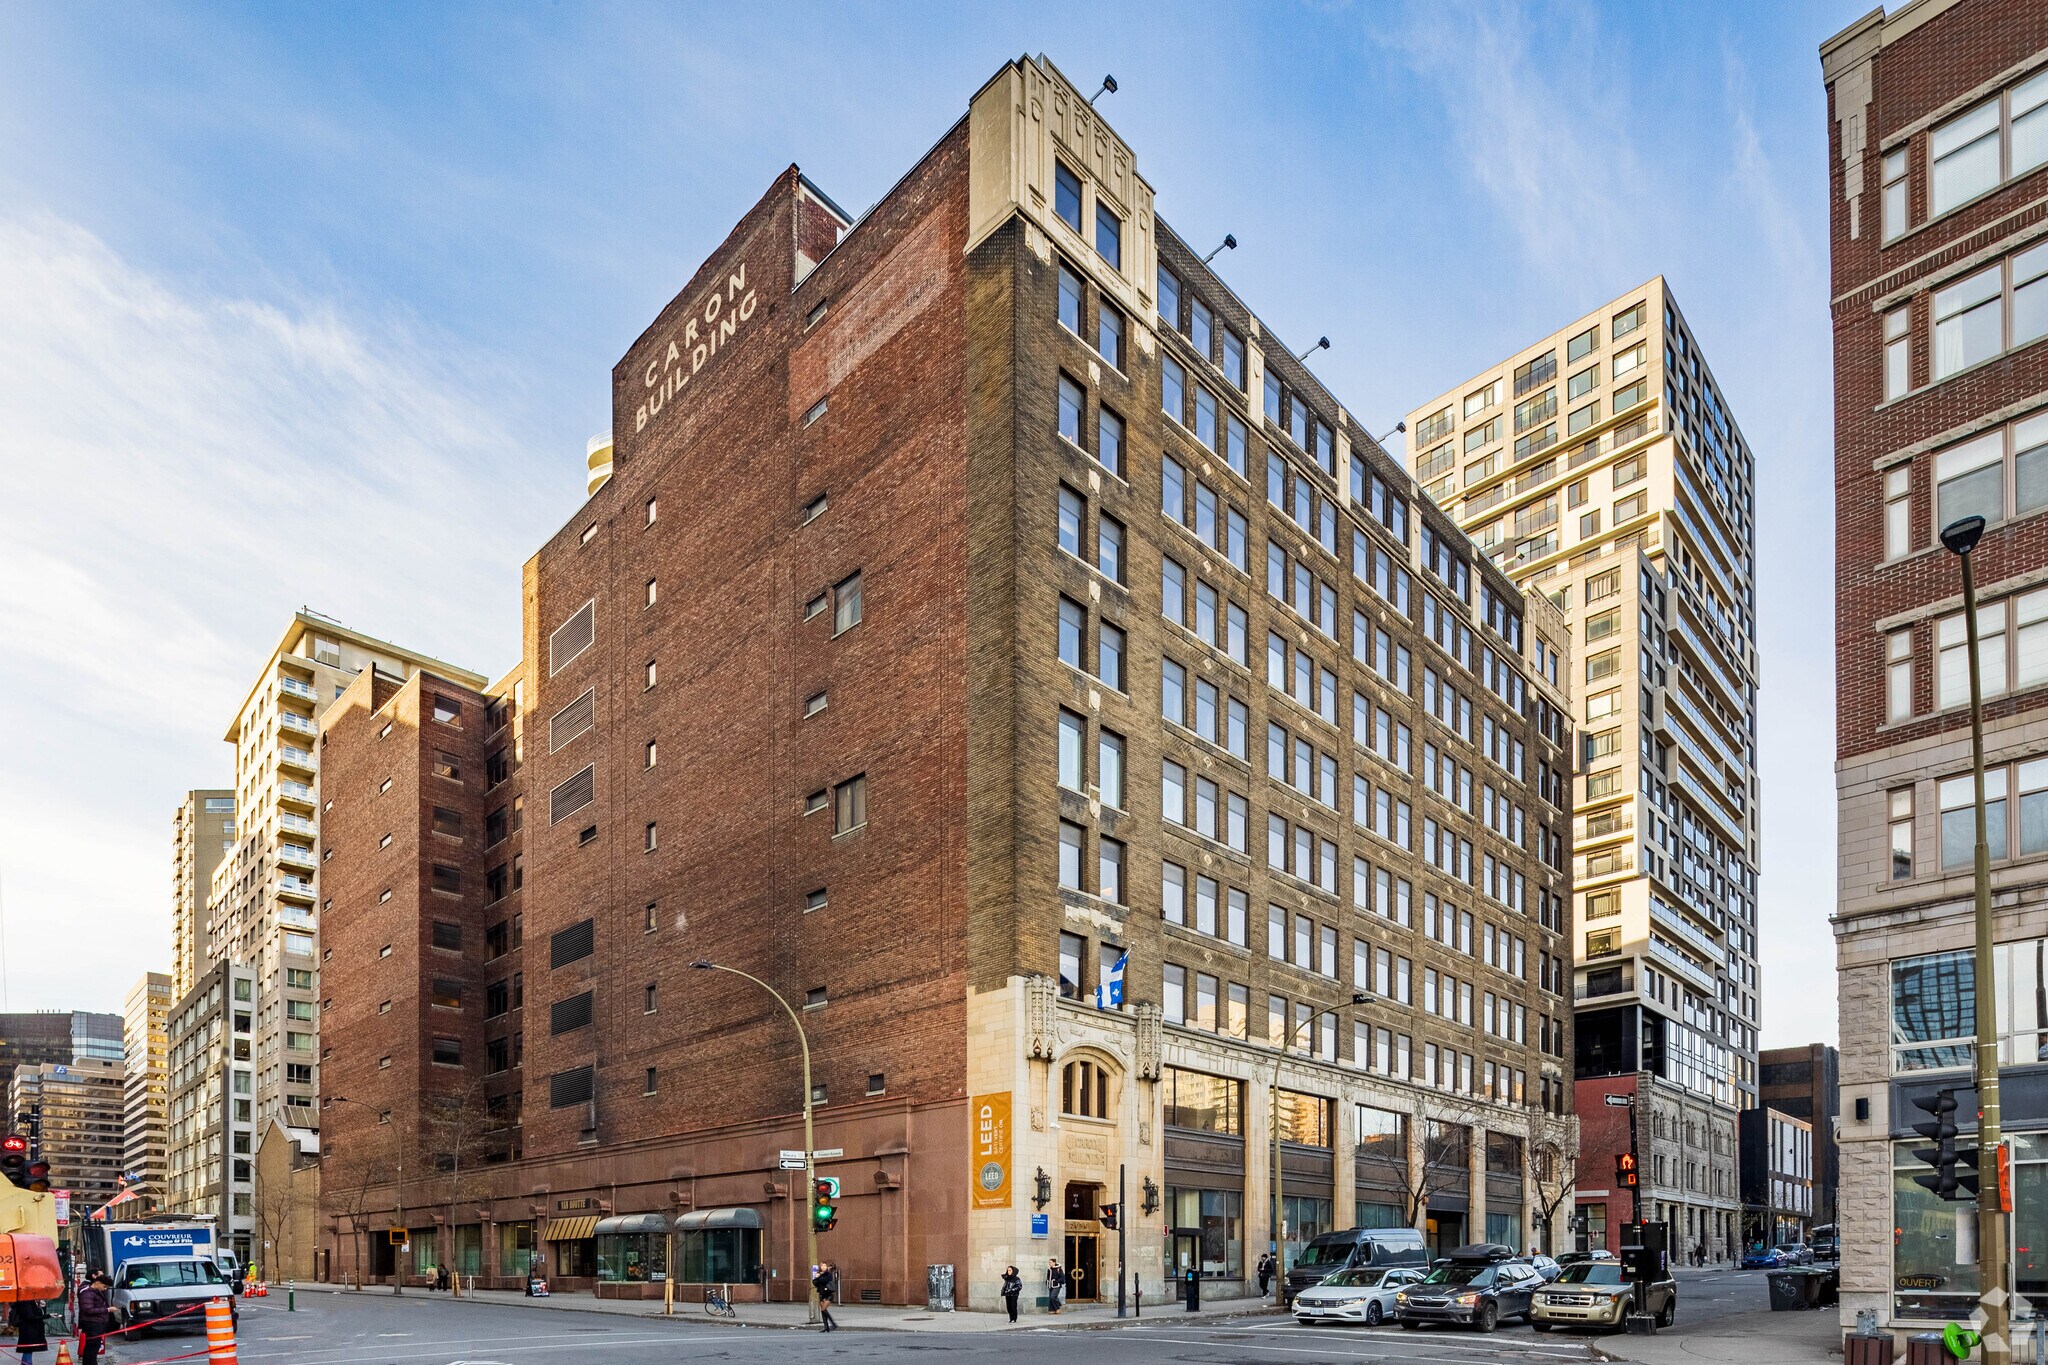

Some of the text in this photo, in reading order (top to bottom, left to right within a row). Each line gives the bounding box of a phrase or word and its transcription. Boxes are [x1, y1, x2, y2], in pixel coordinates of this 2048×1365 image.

[645, 263, 746, 388] CARON
[636, 289, 757, 433] BUILDING
[980, 1105, 993, 1156] LEED
[985, 1172, 999, 1181] LEED
[1900, 1278, 1937, 1287] OUVERT
